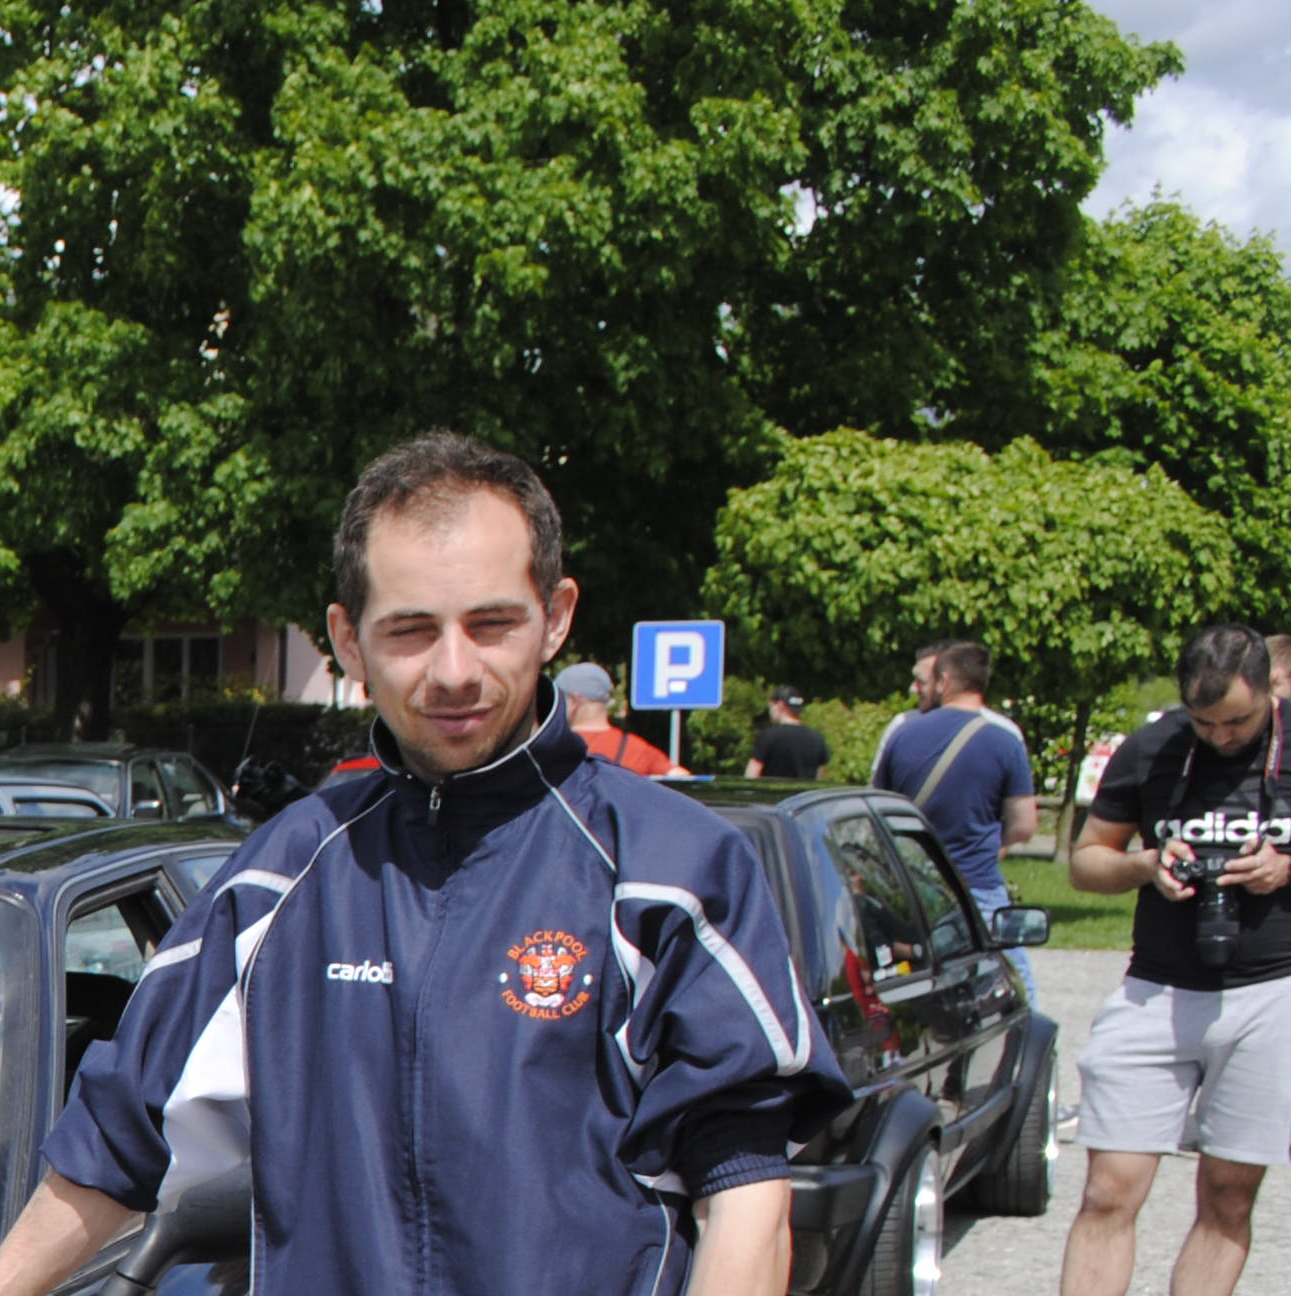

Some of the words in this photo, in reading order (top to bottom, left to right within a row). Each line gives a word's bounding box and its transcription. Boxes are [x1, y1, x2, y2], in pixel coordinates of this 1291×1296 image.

[653, 631, 706, 698] P
[507, 930, 588, 961] BLACKPOOL
[501, 989, 562, 1020] FOOTBALL
[561, 991, 591, 1016] CLUB
